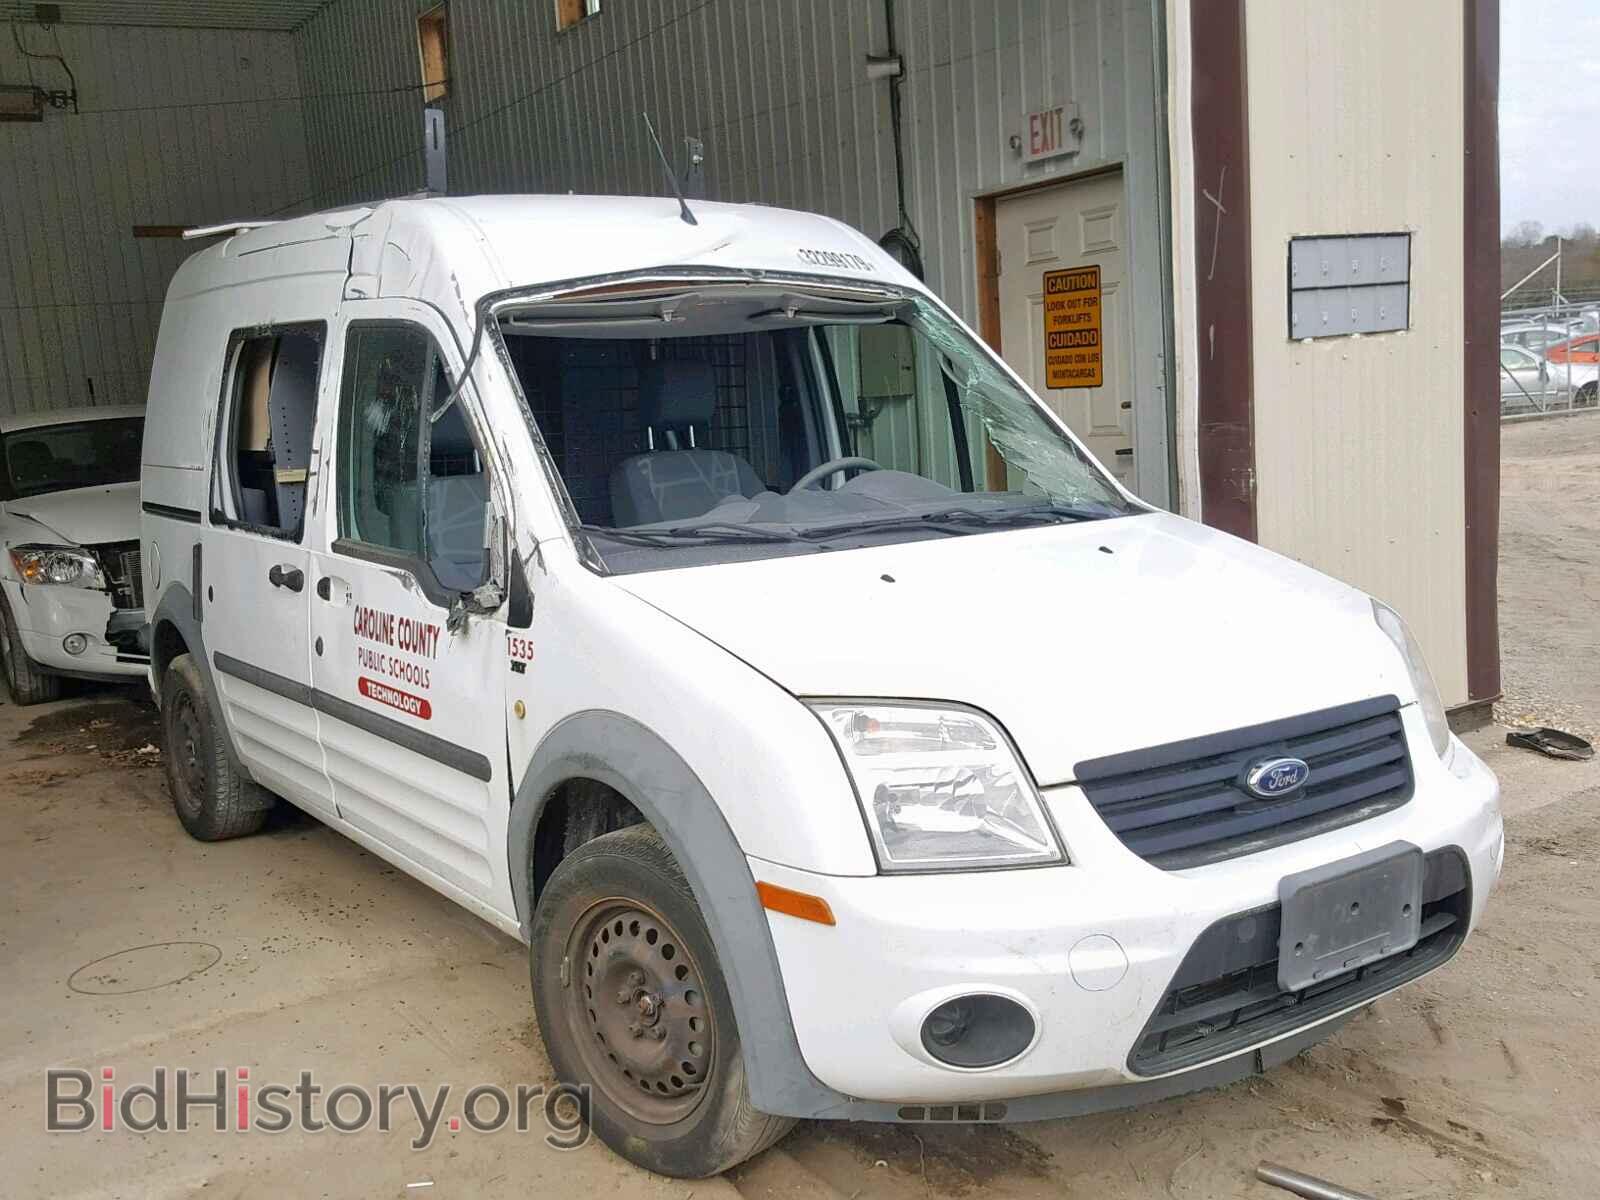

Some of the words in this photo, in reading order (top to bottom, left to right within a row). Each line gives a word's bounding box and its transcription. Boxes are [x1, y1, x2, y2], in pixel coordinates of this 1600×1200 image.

[1029, 108, 1065, 155] EXIT
[1048, 272, 1096, 293] CAUTION
[1047, 301, 1066, 312] LOOK
[1066, 299, 1082, 310] OUT
[1083, 296, 1098, 308] FOR
[1053, 313, 1092, 325] FORKLIFTS
[1049, 330, 1097, 348] CUIDADO
[1048, 355, 1073, 366] CUIDADO
[1087, 352, 1100, 363] LOS
[354, 605, 394, 647] CAROLINE
[398, 617, 440, 660] COUNTY
[507, 636, 534, 660] 1535
[358, 647, 385, 674] PUBLIC
[389, 657, 430, 690] SCHOOLS
[366, 681, 422, 715] TECHNOLOGY
[1268, 766, 1298, 789] Ford
